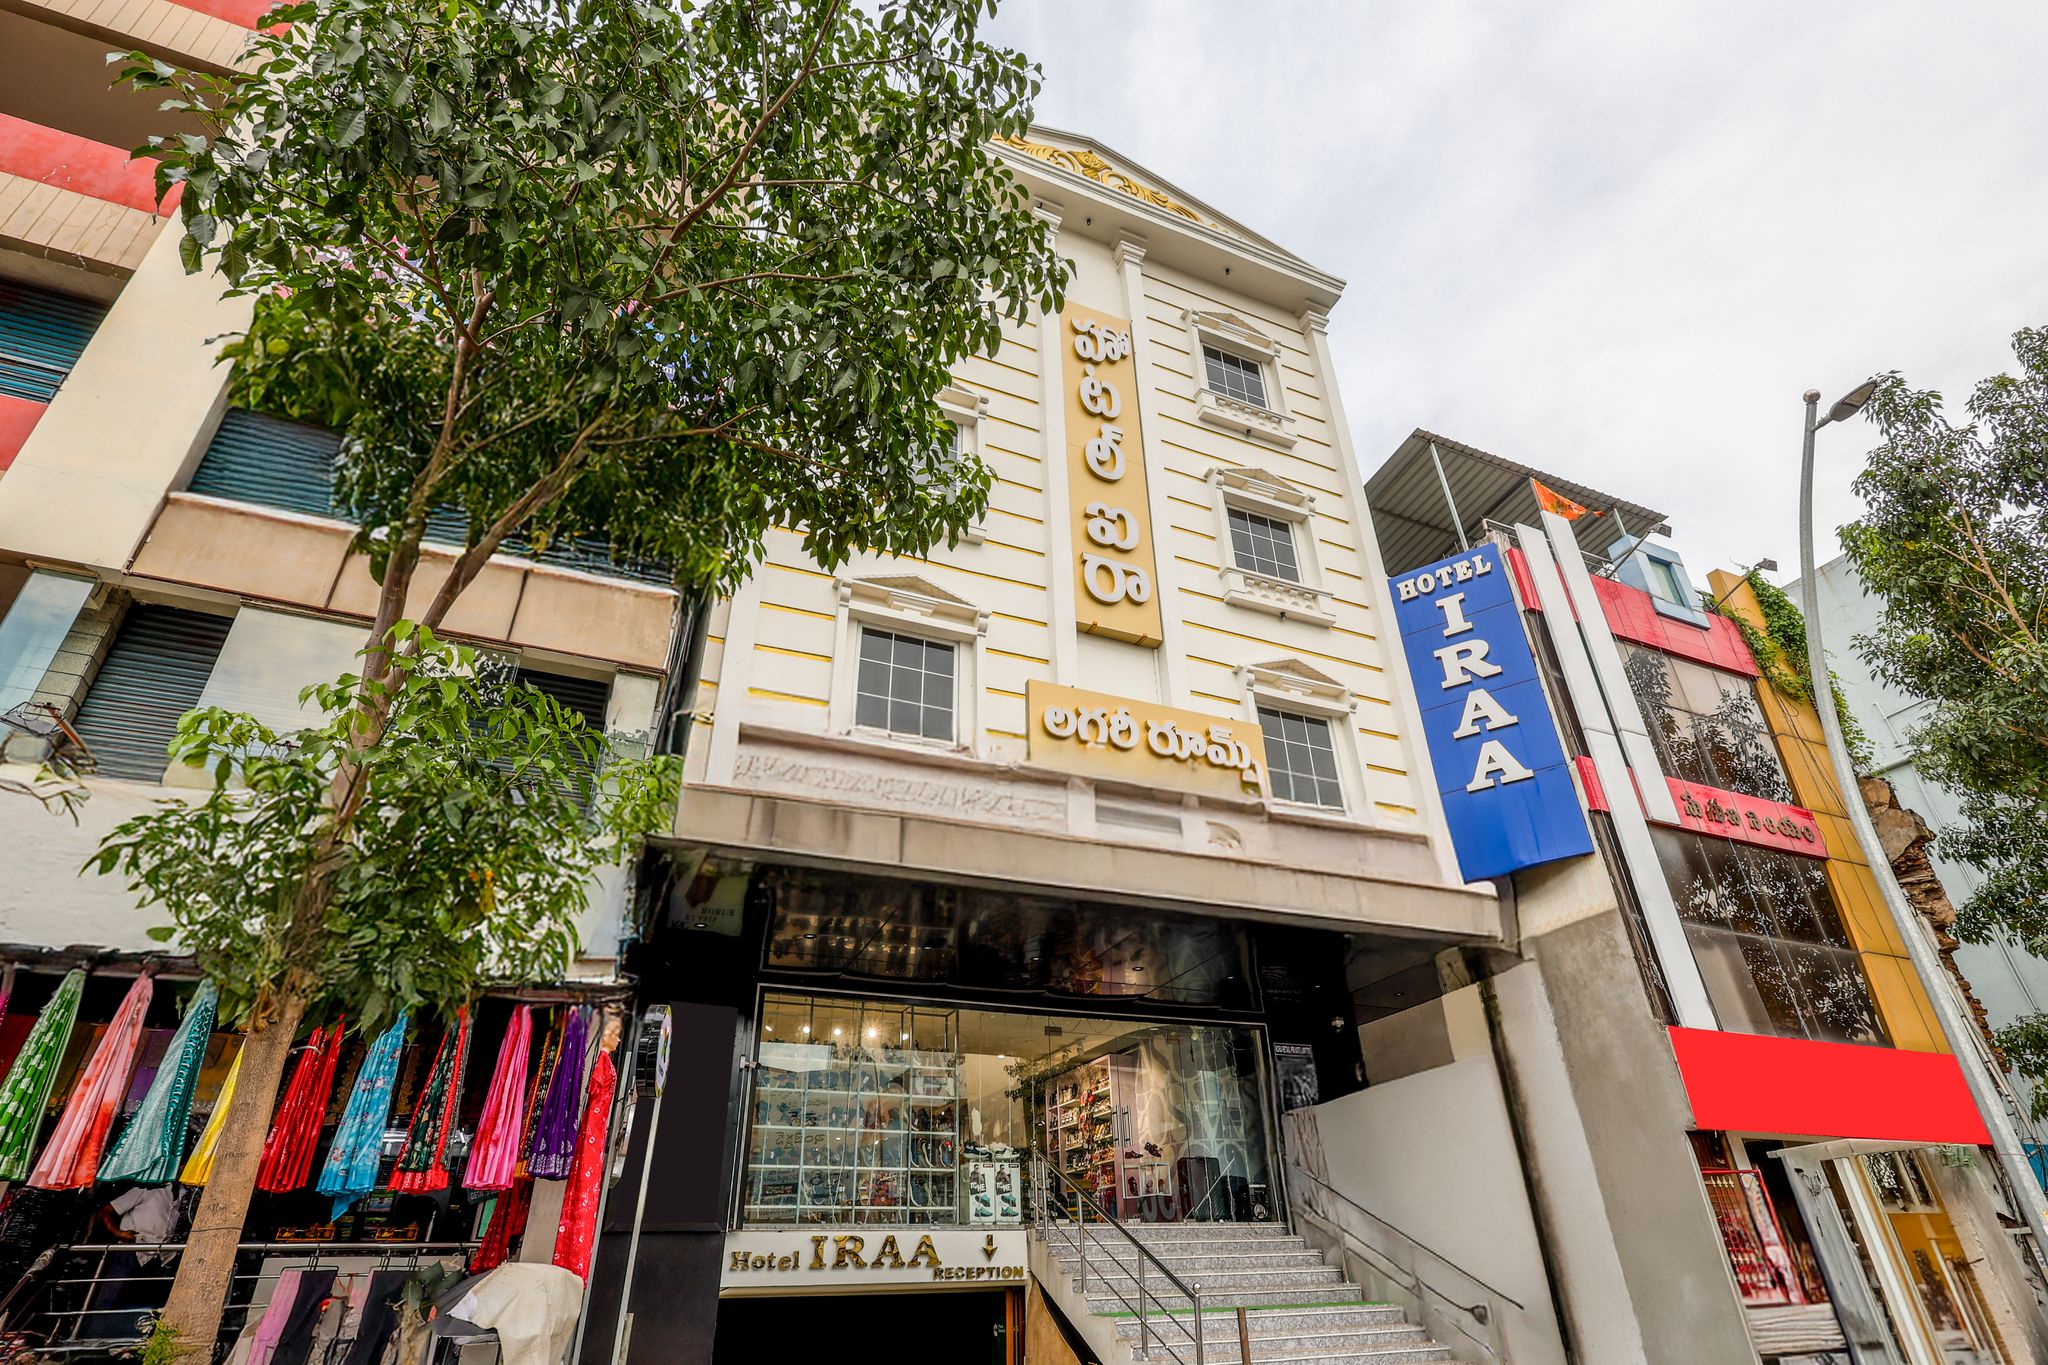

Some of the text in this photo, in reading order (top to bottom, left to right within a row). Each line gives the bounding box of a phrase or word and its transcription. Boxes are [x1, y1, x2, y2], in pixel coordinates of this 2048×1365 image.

[1083, 501, 1152, 604] ఐరా
[1396, 554, 1492, 602] HOTEL
[1433, 591, 1535, 794] IRAA
[729, 1234, 942, 1272] Hotel IRAA
[933, 1265, 1024, 1281] RECEPTION
